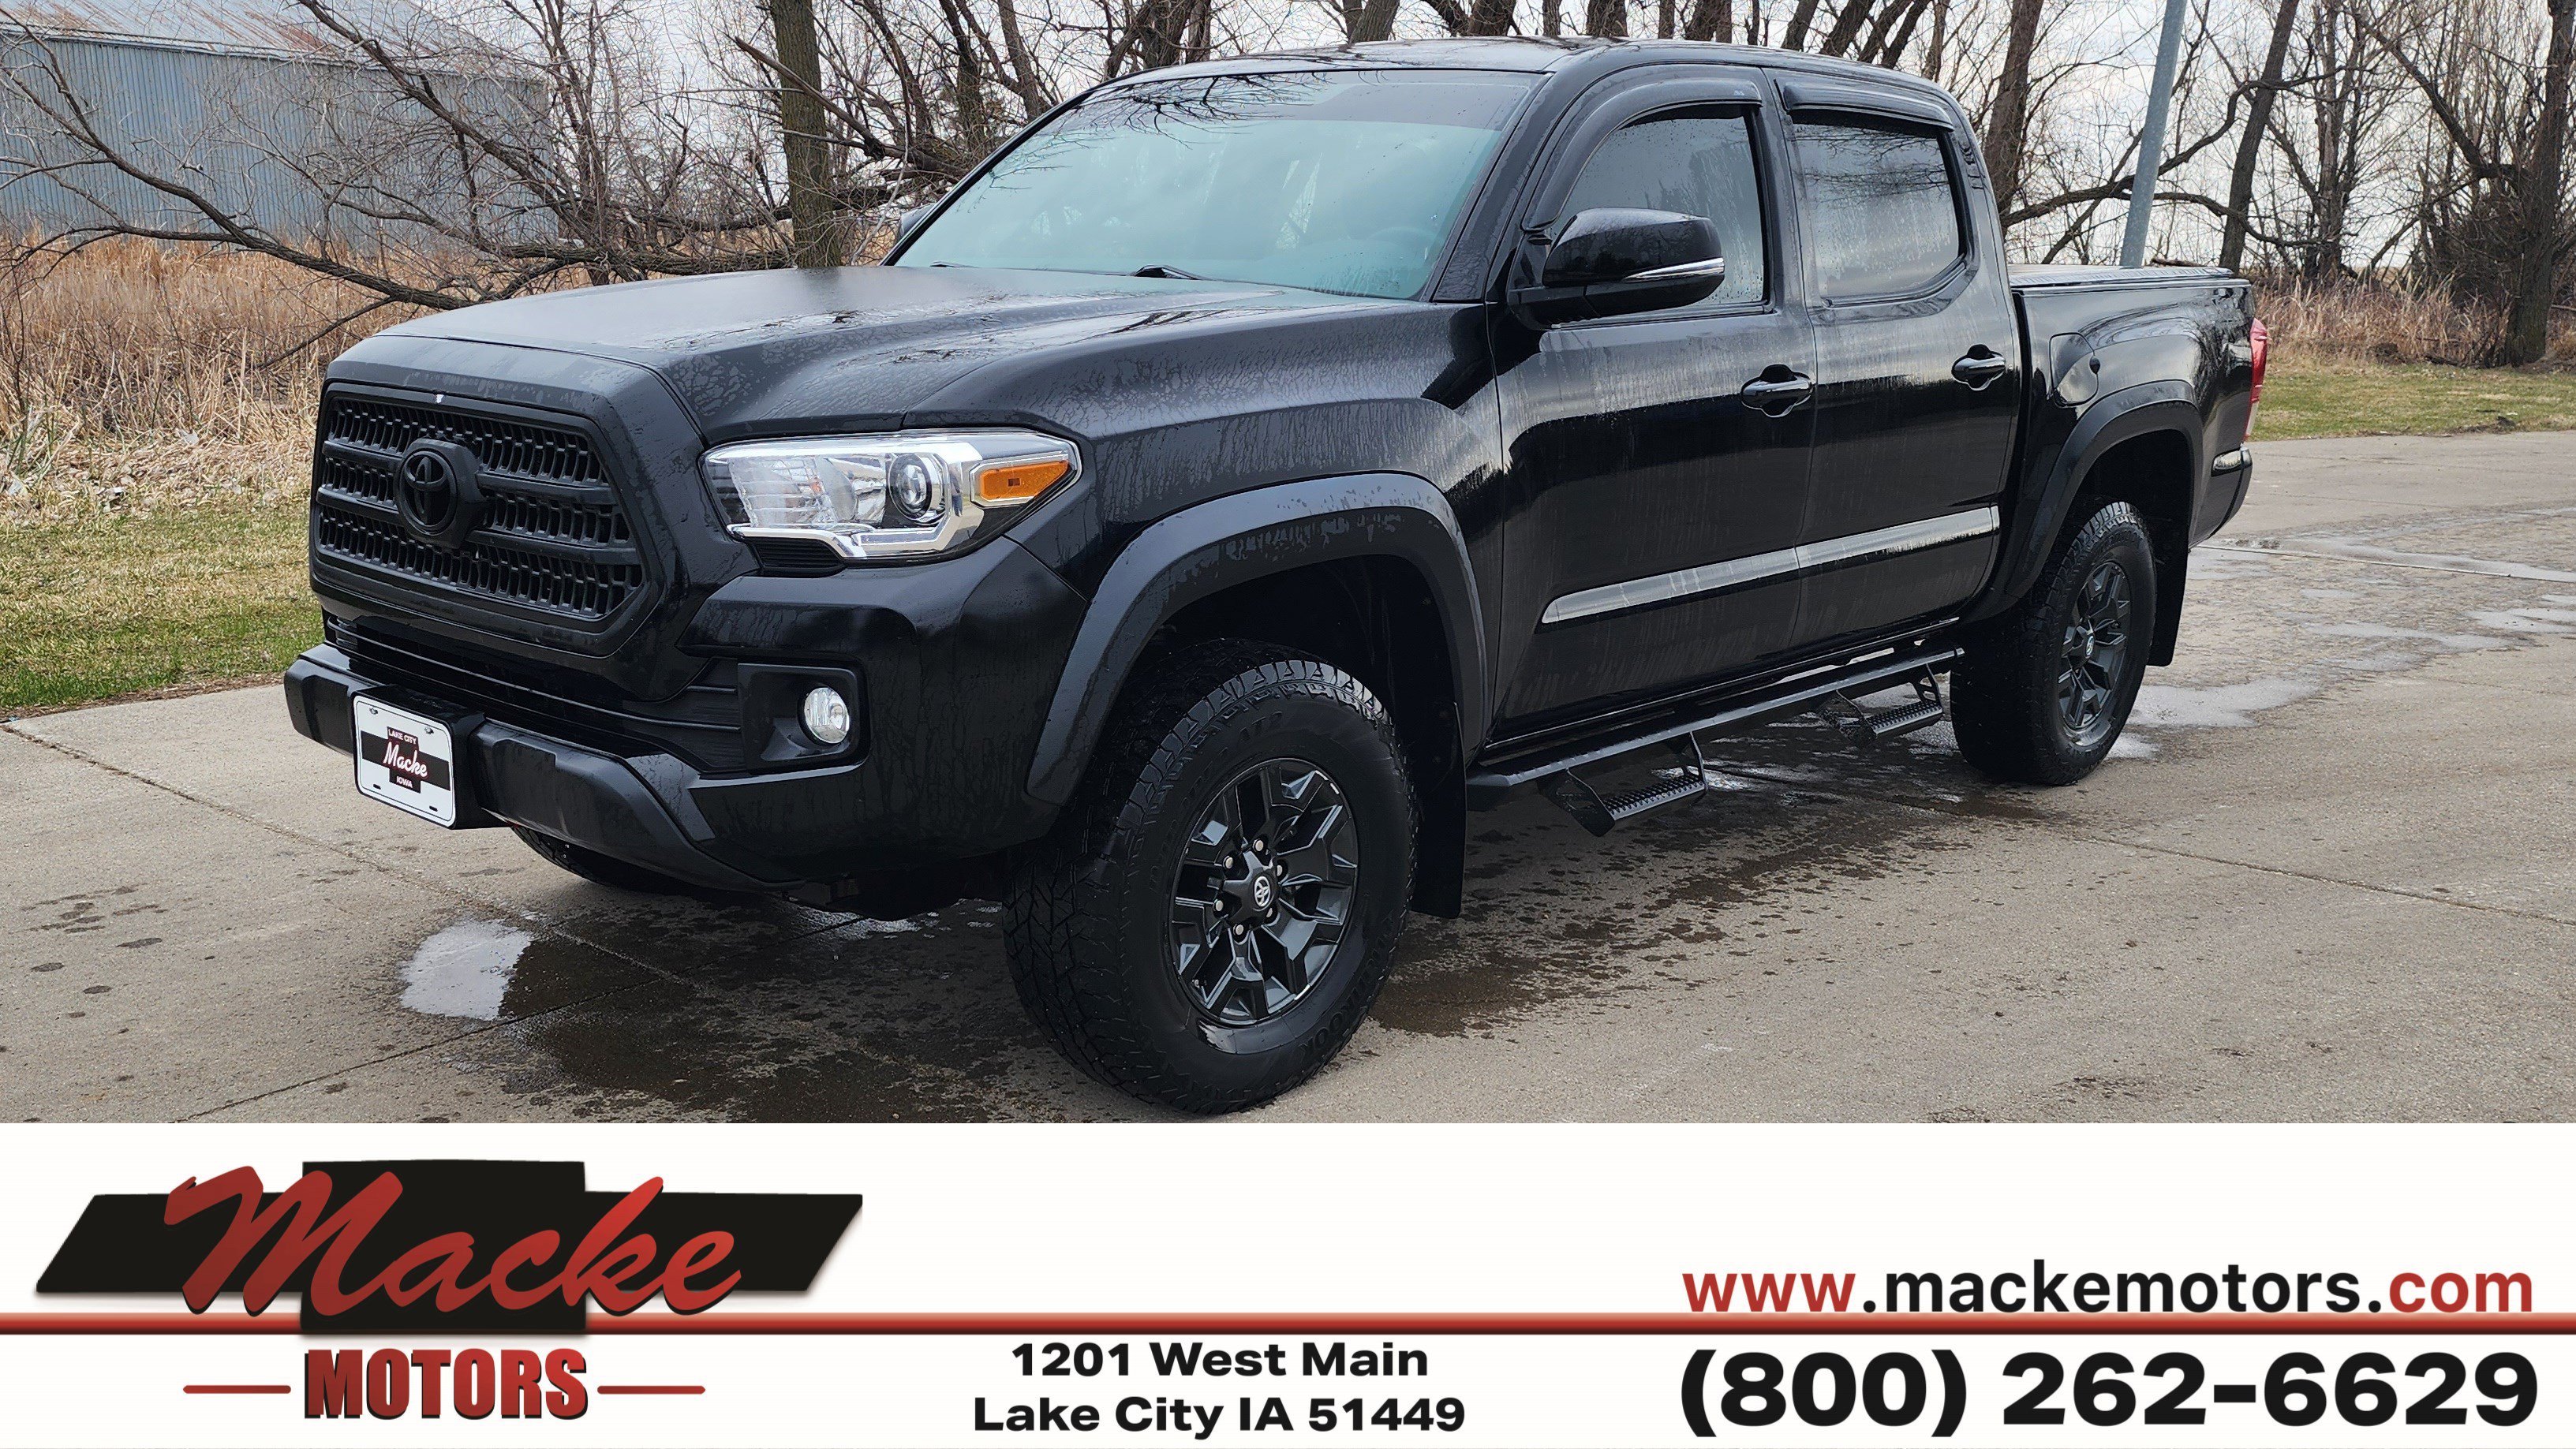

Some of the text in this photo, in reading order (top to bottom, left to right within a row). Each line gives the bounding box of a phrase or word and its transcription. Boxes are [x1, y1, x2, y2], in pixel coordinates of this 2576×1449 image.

[388, 728, 417, 745] LAKE CITY
[383, 741, 428, 777] Macke
[396, 775, 413, 788] IOWA
